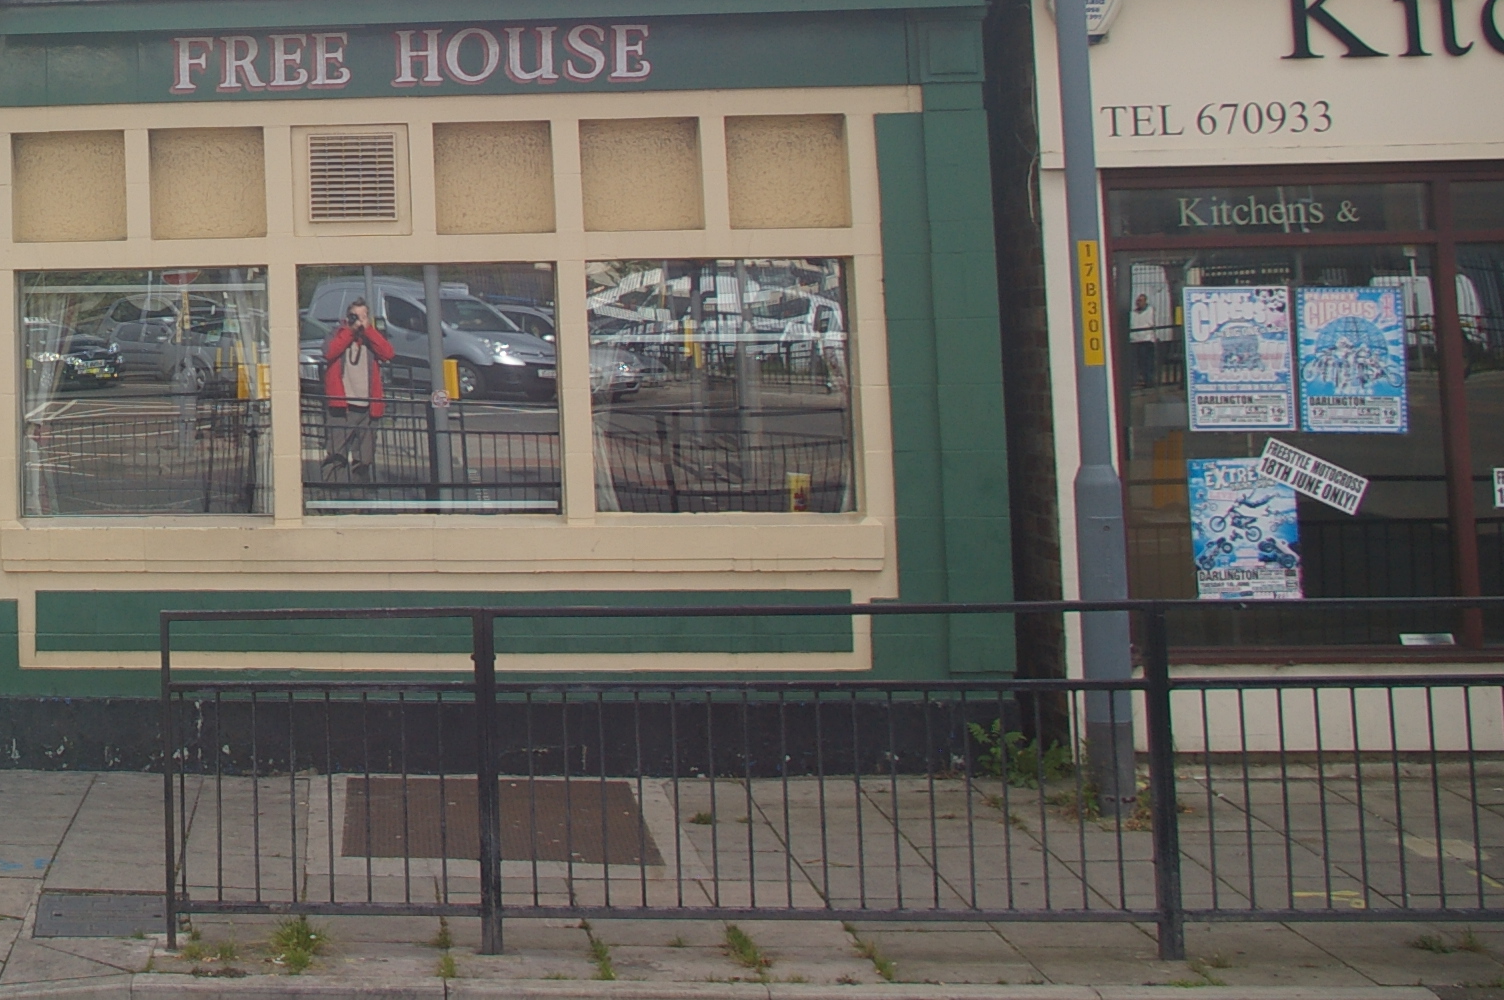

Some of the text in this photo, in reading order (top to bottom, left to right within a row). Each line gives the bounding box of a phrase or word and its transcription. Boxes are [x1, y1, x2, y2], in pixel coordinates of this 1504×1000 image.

[170, 24, 651, 93] FREE HOUSE
[1100, 100, 1334, 138] TEL 670933
[1178, 195, 1360, 227] Kitchens &
[1304, 301, 1377, 331] CIRCUS
[1197, 395, 1254, 405] DARLINGTON
[1309, 396, 1366, 406] DARLINGTON
[1204, 466, 1257, 490] EXTRE
[1266, 441, 1312, 470] FREESTYLE
[1310, 460, 1365, 494] MOTOCROSS
[1261, 457, 1293, 483] 18TH
[1290, 470, 1323, 495] JUNE
[1321, 483, 1358, 511] ONLY!
[1199, 569, 1258, 581] DARLINGTON
